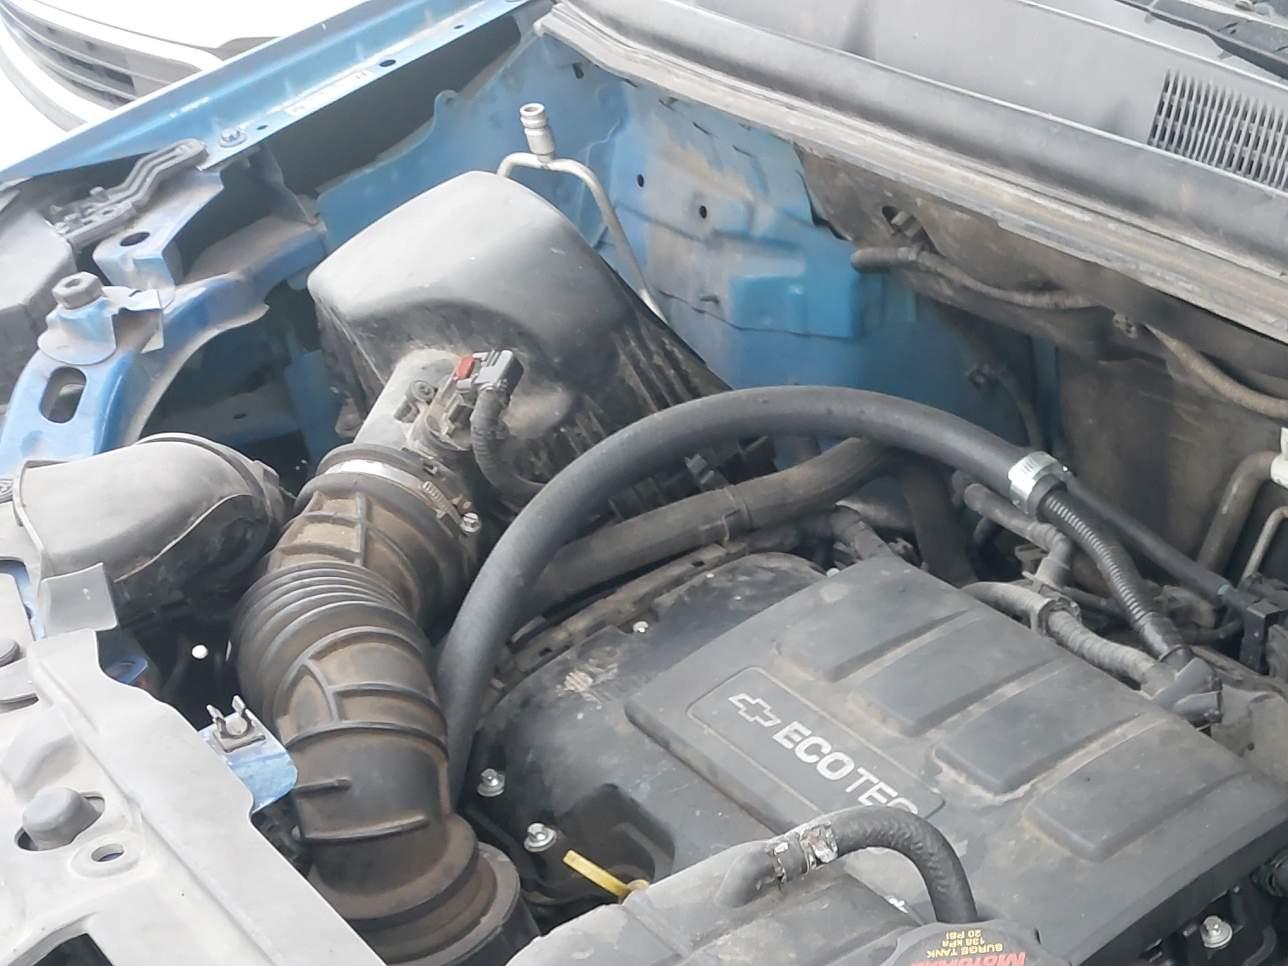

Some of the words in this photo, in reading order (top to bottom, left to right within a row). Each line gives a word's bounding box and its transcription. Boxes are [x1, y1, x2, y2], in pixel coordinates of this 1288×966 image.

[946, 931, 965, 940] PSI
[968, 929, 982, 938] 20
[927, 948, 959, 959] TANK
[960, 943, 1004, 955] SURGE
